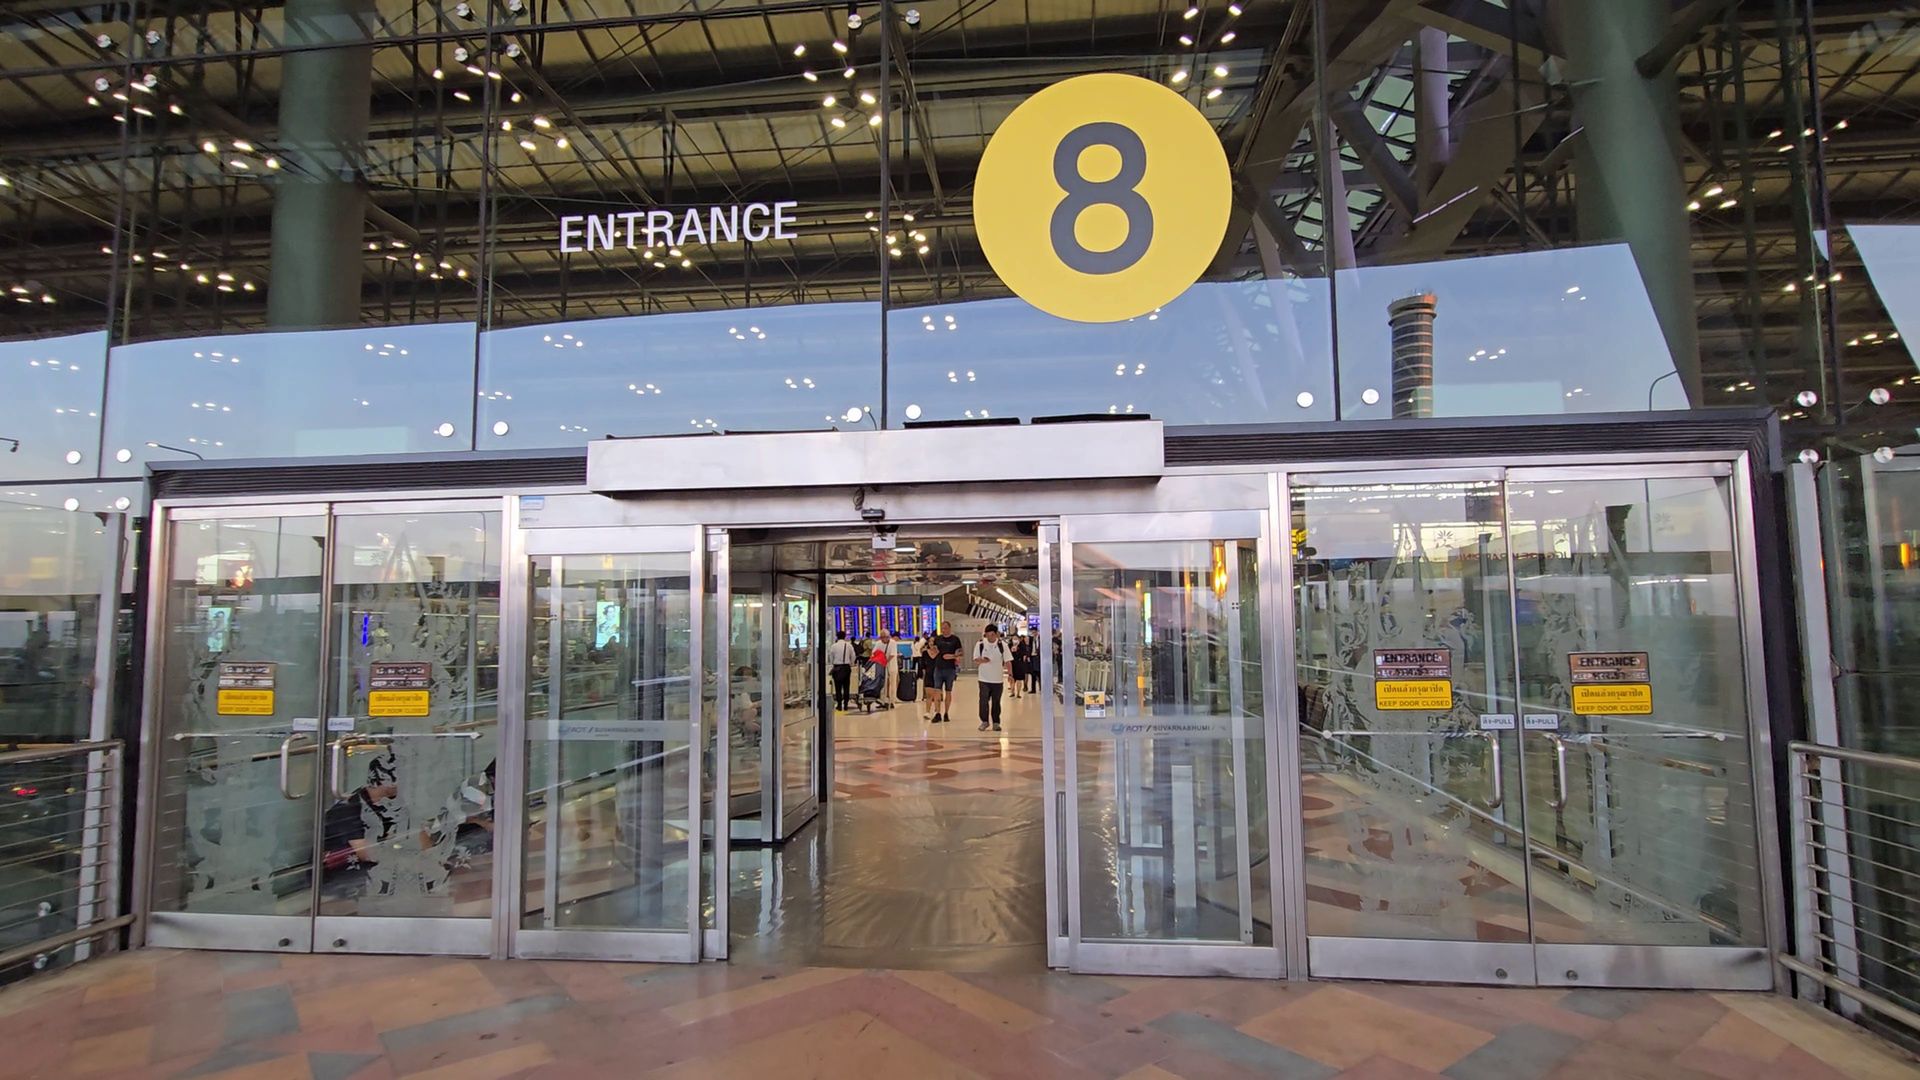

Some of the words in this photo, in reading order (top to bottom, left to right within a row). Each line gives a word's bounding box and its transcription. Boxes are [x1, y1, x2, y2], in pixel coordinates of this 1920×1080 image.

[1050, 122, 1154, 275] 8
[561, 201, 798, 253] ENTRANCE
[1384, 653, 1439, 663] ENTRANCE
[1580, 656, 1637, 667] ENTRANCE
